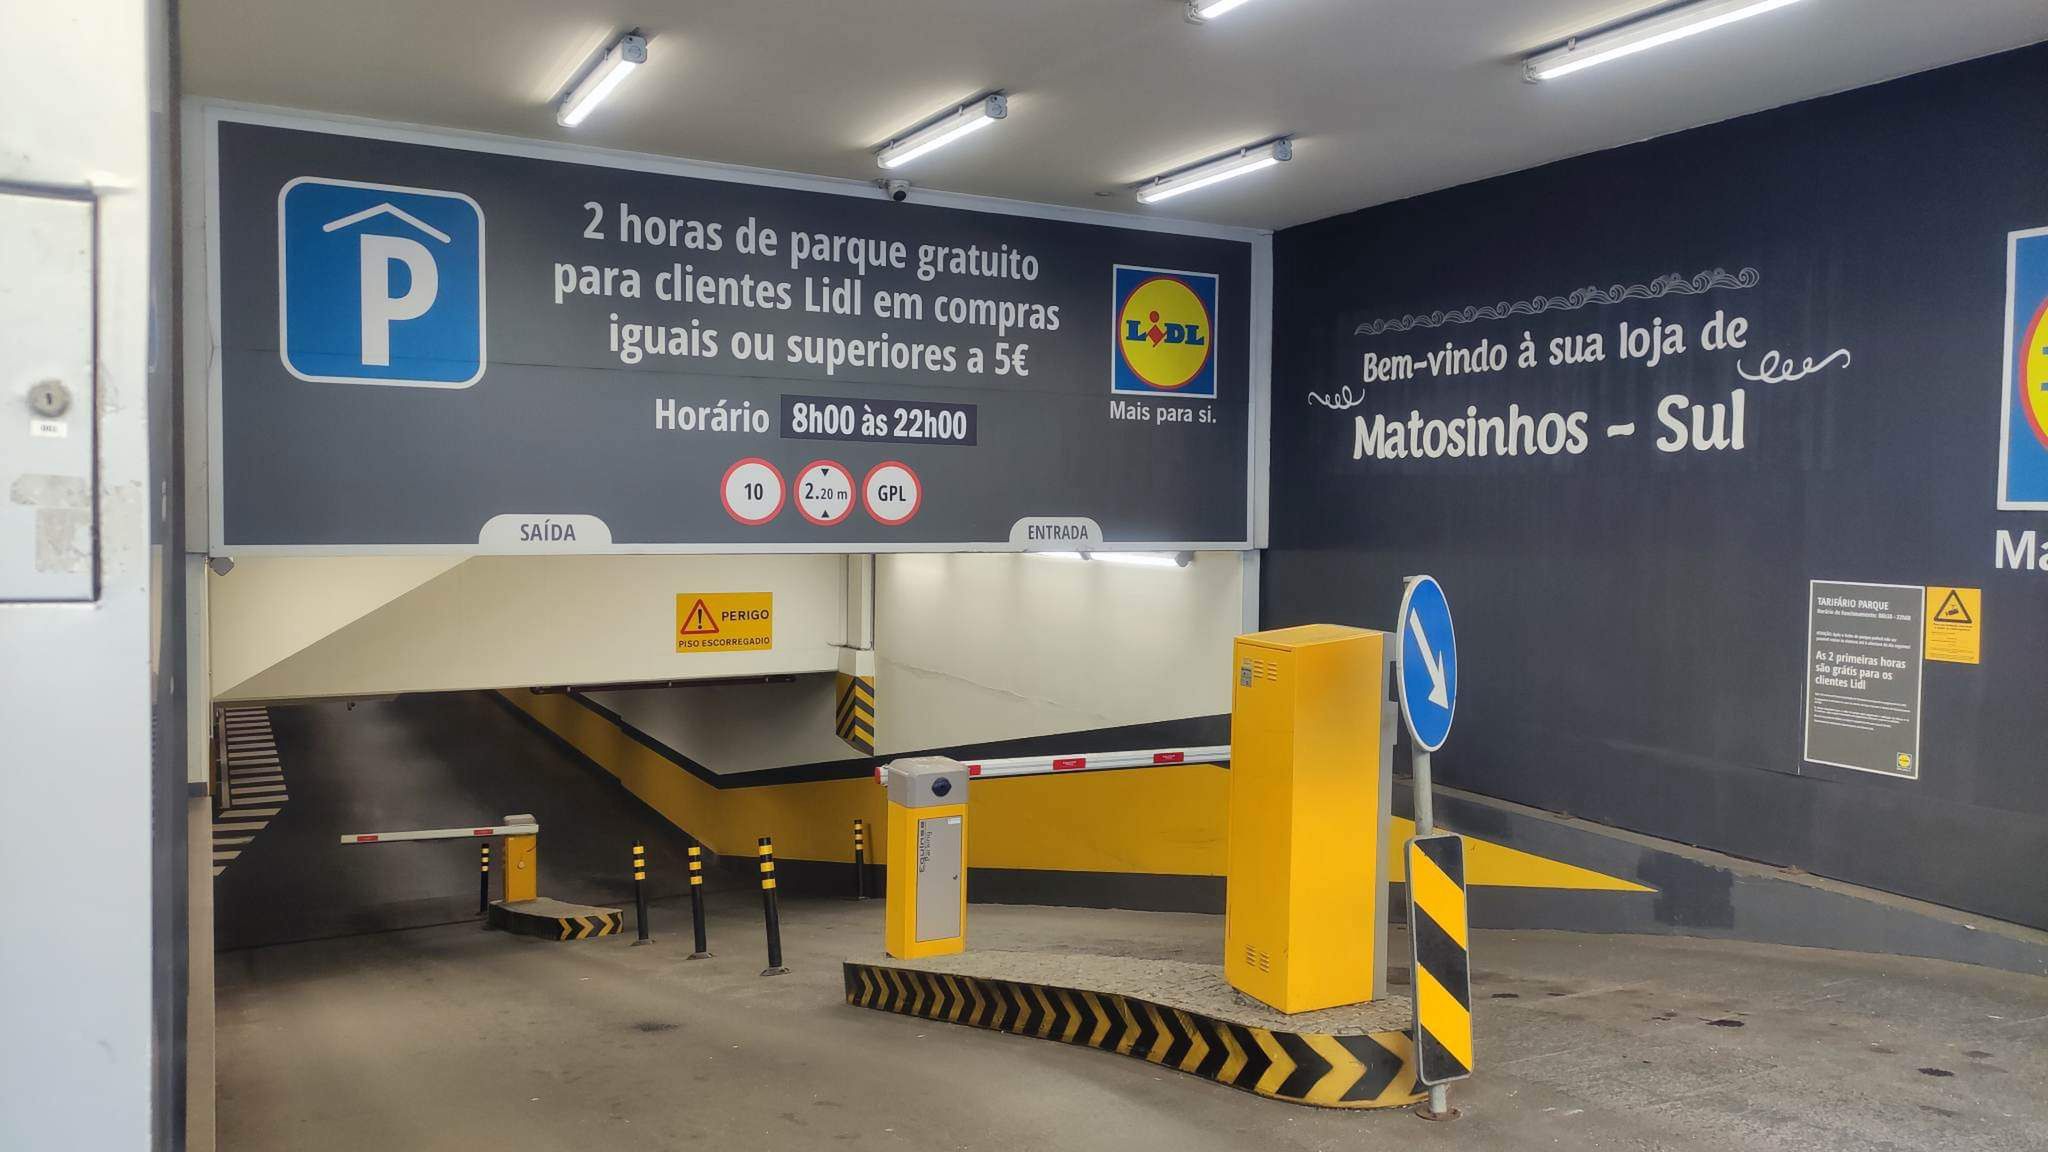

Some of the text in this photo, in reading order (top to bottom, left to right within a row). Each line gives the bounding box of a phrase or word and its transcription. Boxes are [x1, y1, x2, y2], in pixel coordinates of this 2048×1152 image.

[584, 202, 1038, 281] 2 horas de parque gratuito
[360, 234, 438, 366] P
[555, 263, 1059, 336] para clientes Lidl em compras
[610, 313, 1028, 376] iguais ou superiores a 5€
[1364, 310, 1748, 382] Bem-vindo à sua loja de
[656, 399, 966, 439] Horário 8h00 às 22h00
[1111, 401, 1216, 425] Mais para si.
[1354, 404, 1588, 459] Matosinhos
[1657, 389, 1745, 452] Sul
[745, 483, 763, 500] 10
[838, 491, 847, 499] m
[878, 485, 906, 501] GPL
[521, 519, 575, 541] SAÍDA
[1029, 525, 1088, 539] ENTRADA
[1818, 597, 1888, 611] TARIFÁRIO PARQUE
[722, 610, 769, 621] PERIGO
[702, 637, 769, 647] ESCORREGADIO
[1816, 651, 1906, 668] As 2 primeiras horas
[1816, 663, 1893, 680] são grátis para os
[1816, 675, 1865, 689] clientes Lidl
